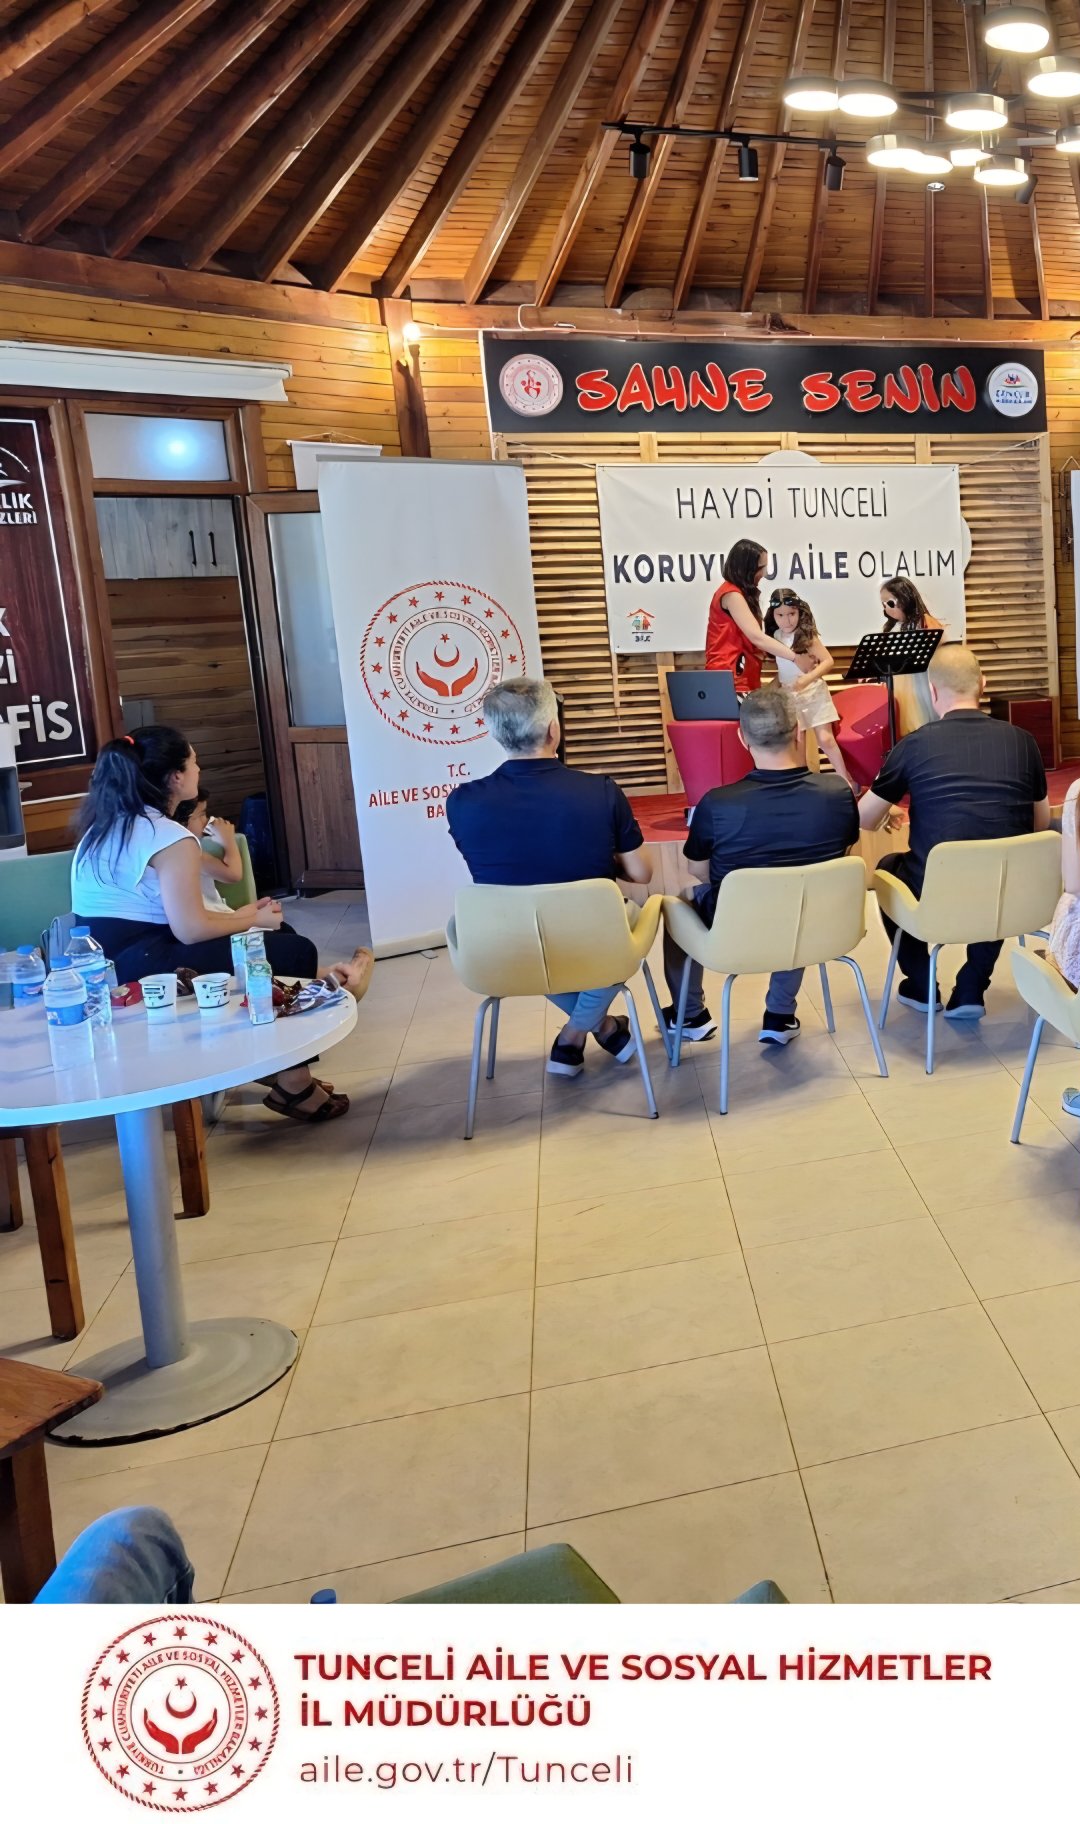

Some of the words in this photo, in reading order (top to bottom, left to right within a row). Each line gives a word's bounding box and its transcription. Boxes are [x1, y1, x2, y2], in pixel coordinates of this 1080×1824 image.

[677, 478, 773, 518] HAYDİ
[787, 480, 887, 518] TUNCELİ
[613, 553, 778, 584] KORUYU
[789, 543, 849, 580] AİLE
[858, 550, 955, 578] OLALIM
[0, 695, 73, 746] FİS
[447, 762, 471, 777] T.C.
[368, 789, 399, 807] AİLE
[401, 787, 419, 802] VE
